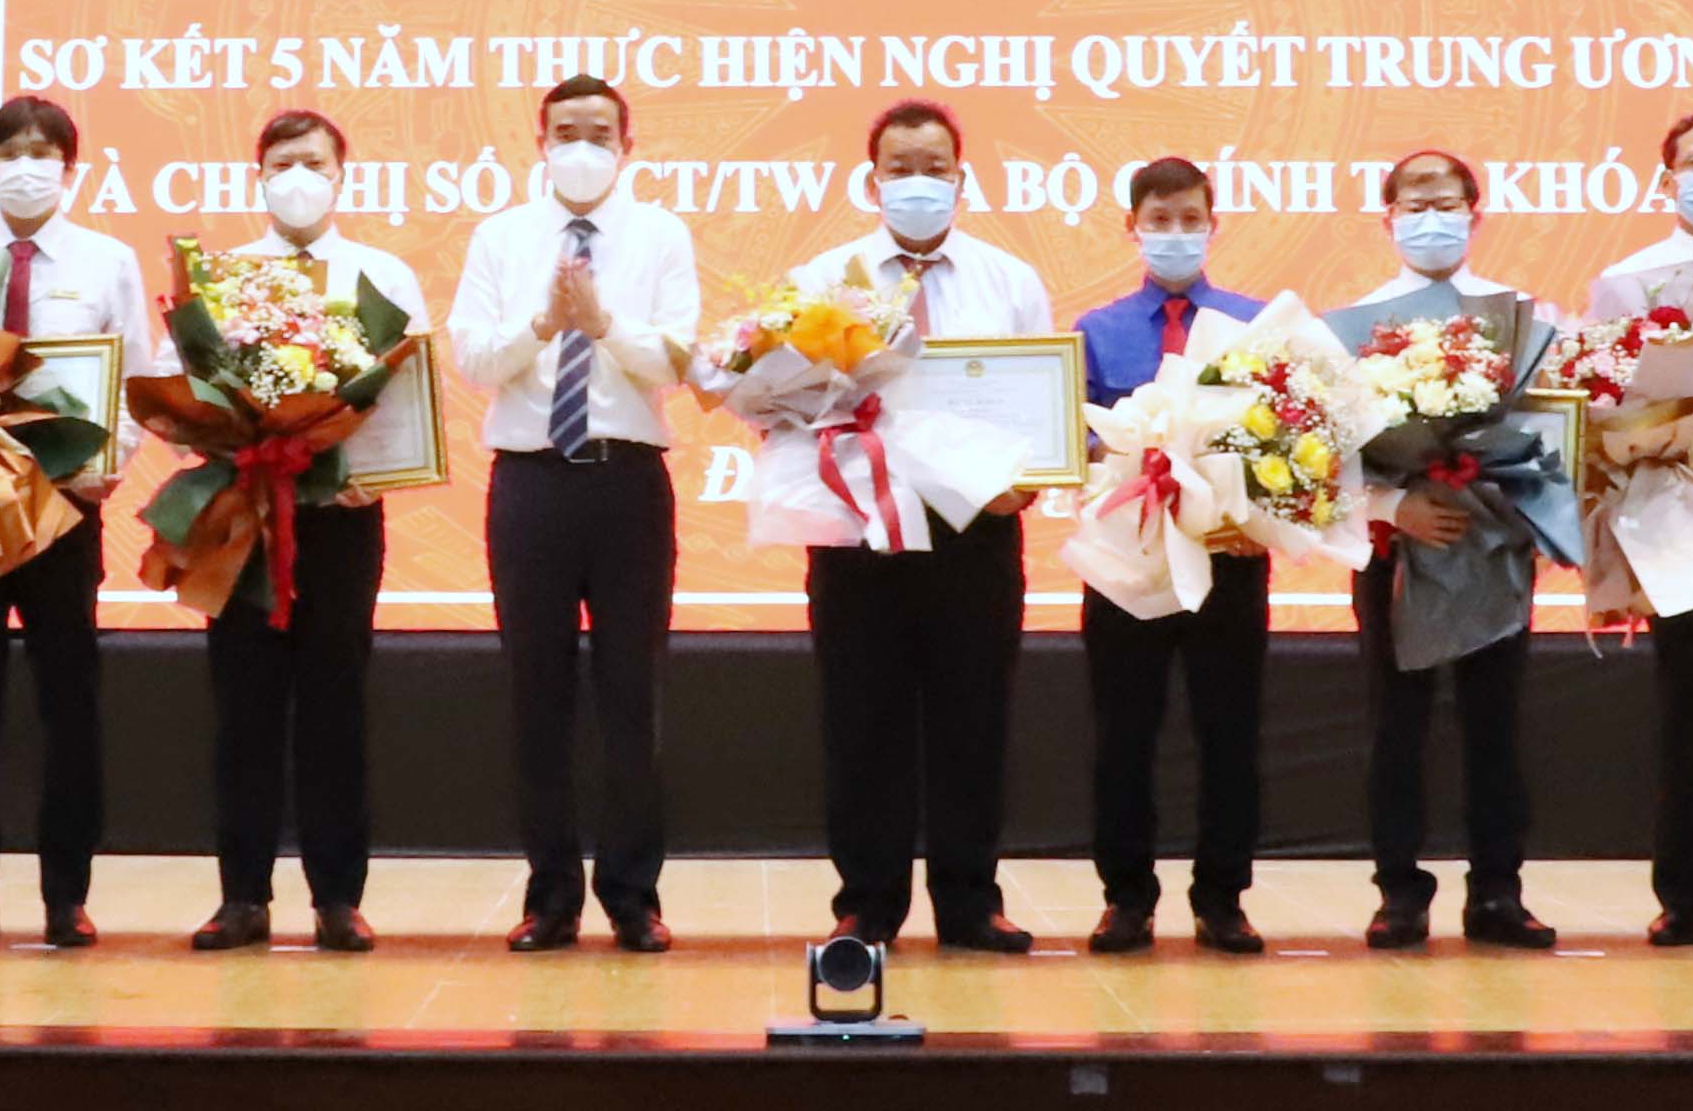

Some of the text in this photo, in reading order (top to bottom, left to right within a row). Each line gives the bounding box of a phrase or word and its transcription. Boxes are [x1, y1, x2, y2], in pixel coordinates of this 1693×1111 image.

[19, 35, 108, 91] SƠ
[120, 23, 257, 89] KẾT
[270, 38, 304, 89] 5
[318, 24, 474, 88] NĂM
[698, 28, 866, 101] HIỆN
[880, 35, 1056, 101] NGHỊ
[1071, 20, 1306, 99] QUYẾT
[1317, 36, 1556, 88] TRUNG
[336, 161, 409, 227] HỊ
[425, 146, 512, 213] SỐ
[1003, 153, 1099, 226] BỘ
